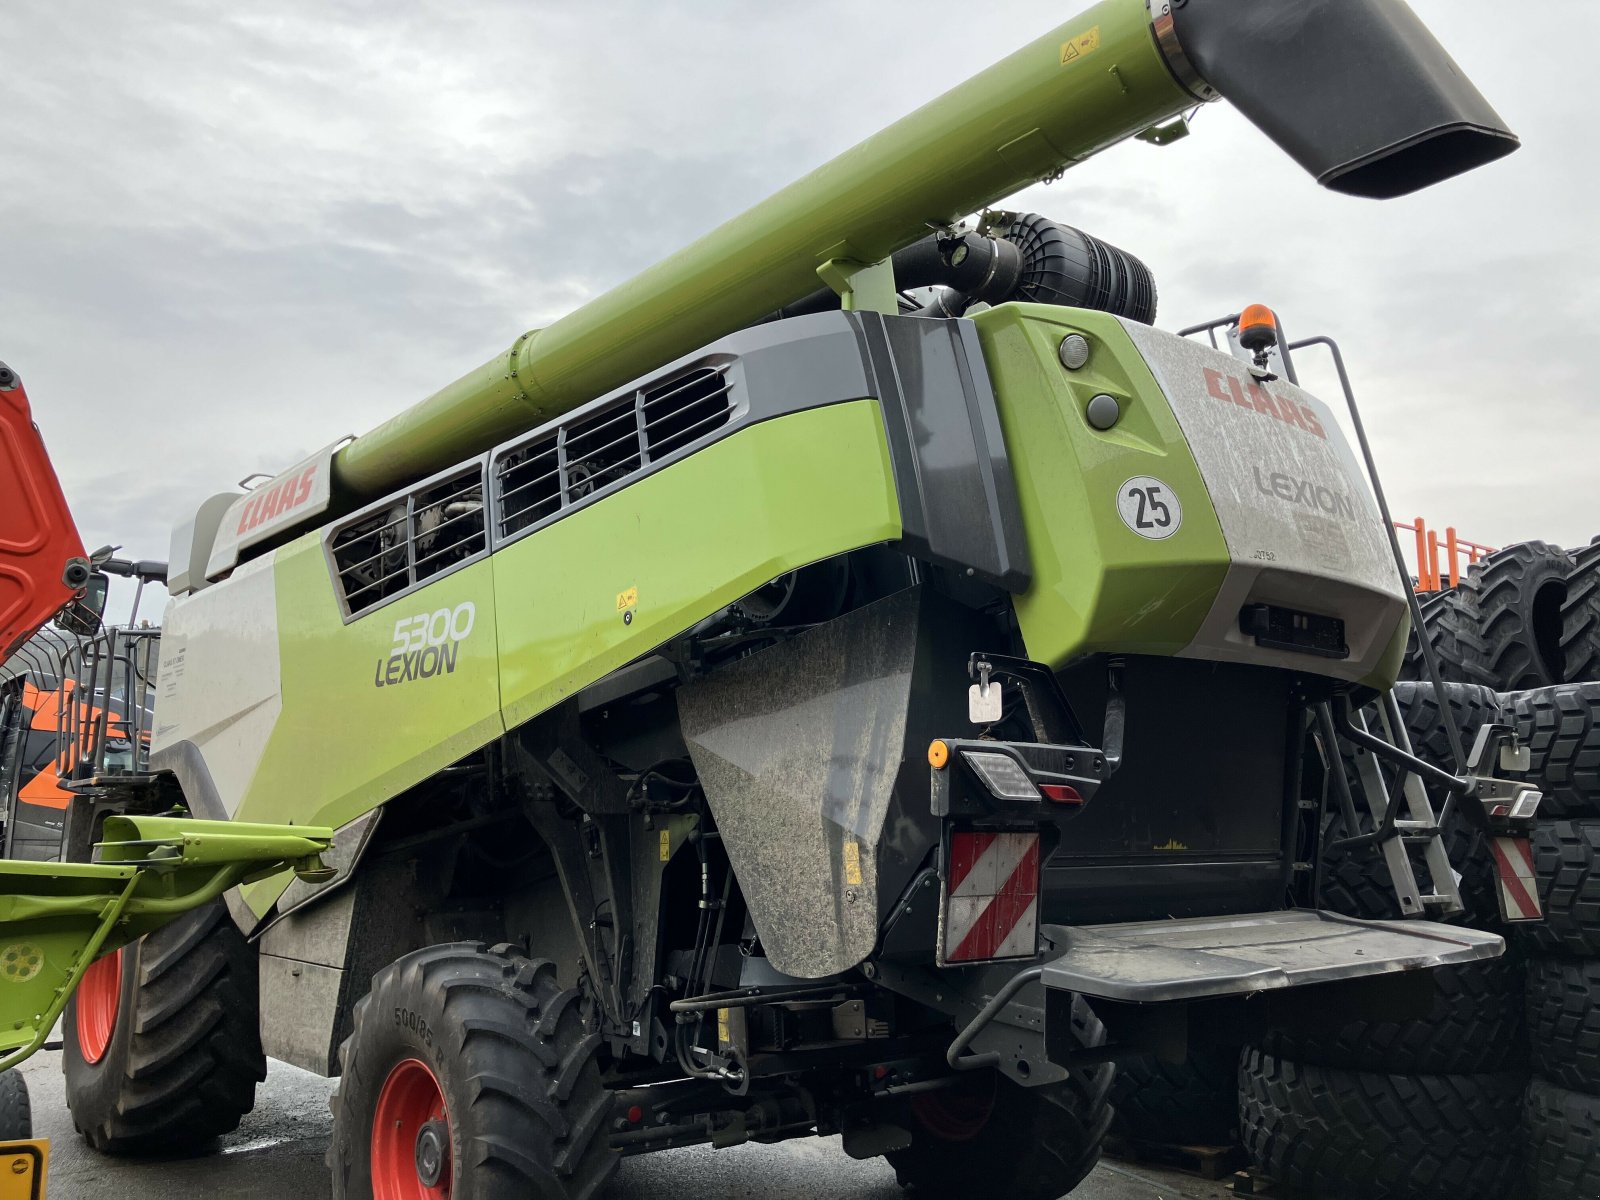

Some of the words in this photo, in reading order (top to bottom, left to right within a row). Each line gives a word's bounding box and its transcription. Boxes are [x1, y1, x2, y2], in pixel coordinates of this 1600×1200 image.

[1203, 367, 1326, 440] CLAAS
[237, 464, 317, 536] CLAAS
[1129, 487, 1171, 528] 25
[1253, 466, 1357, 521] LEXION
[390, 601, 476, 656] 5300
[375, 640, 459, 687] LEXION
[394, 1008, 433, 1048] 500/85
